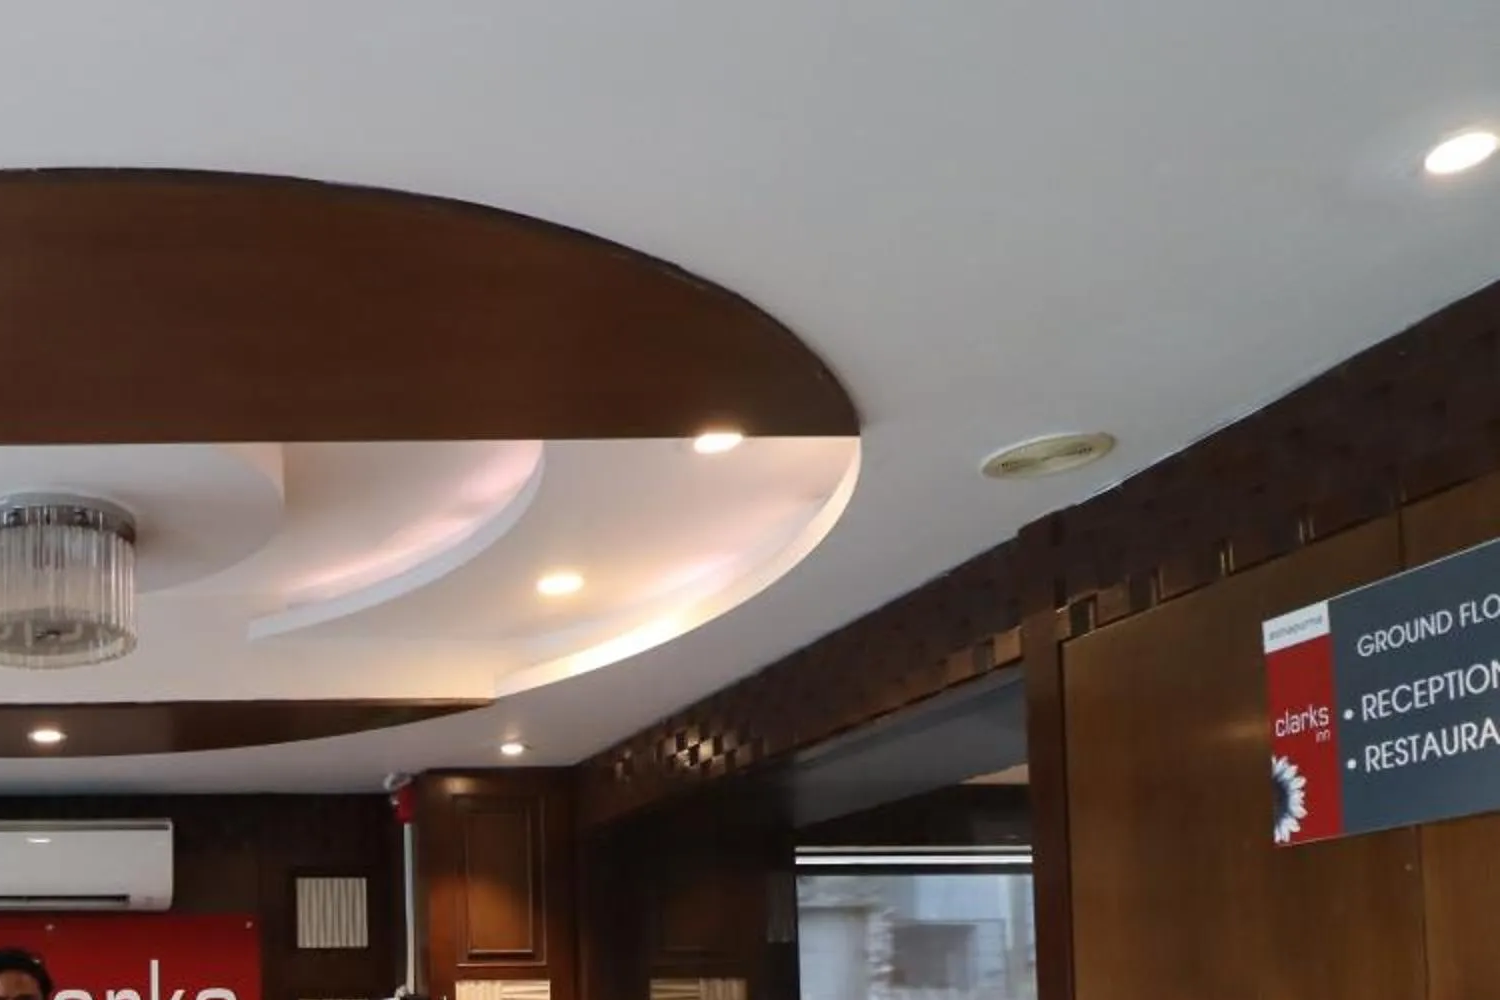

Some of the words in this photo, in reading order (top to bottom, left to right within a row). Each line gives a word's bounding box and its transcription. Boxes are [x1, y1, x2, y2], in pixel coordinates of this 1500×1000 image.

[1357, 608, 1453, 657] GROUND
[1458, 593, 1500, 628] FLO
[1275, 704, 1330, 737] clarks
[1364, 717, 1500, 772] RESTAURA
